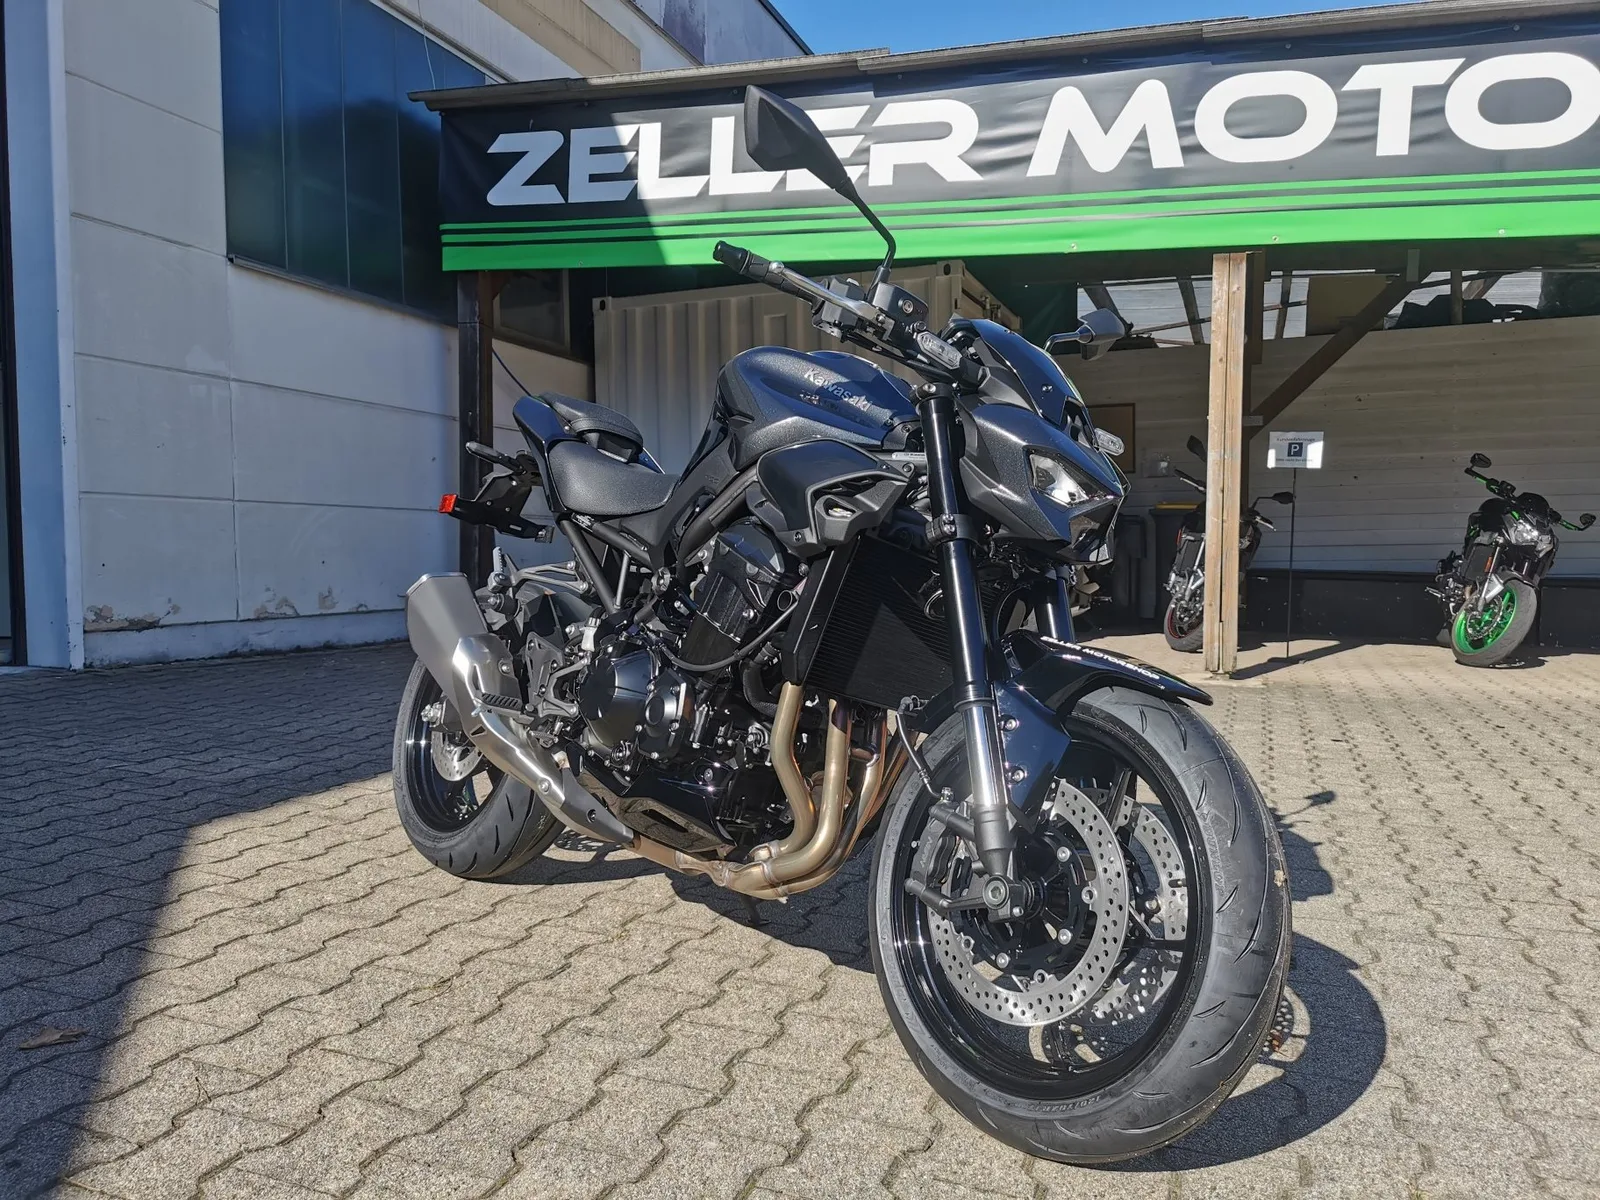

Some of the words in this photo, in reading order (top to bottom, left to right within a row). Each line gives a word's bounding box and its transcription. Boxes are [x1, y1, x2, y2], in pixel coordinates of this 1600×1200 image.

[487, 99, 984, 206] ZELLER
[1026, 52, 1600, 178] MOTO
[804, 368, 873, 412] Kawasaki
[1082, 648, 1160, 680] MOTORSHOP
